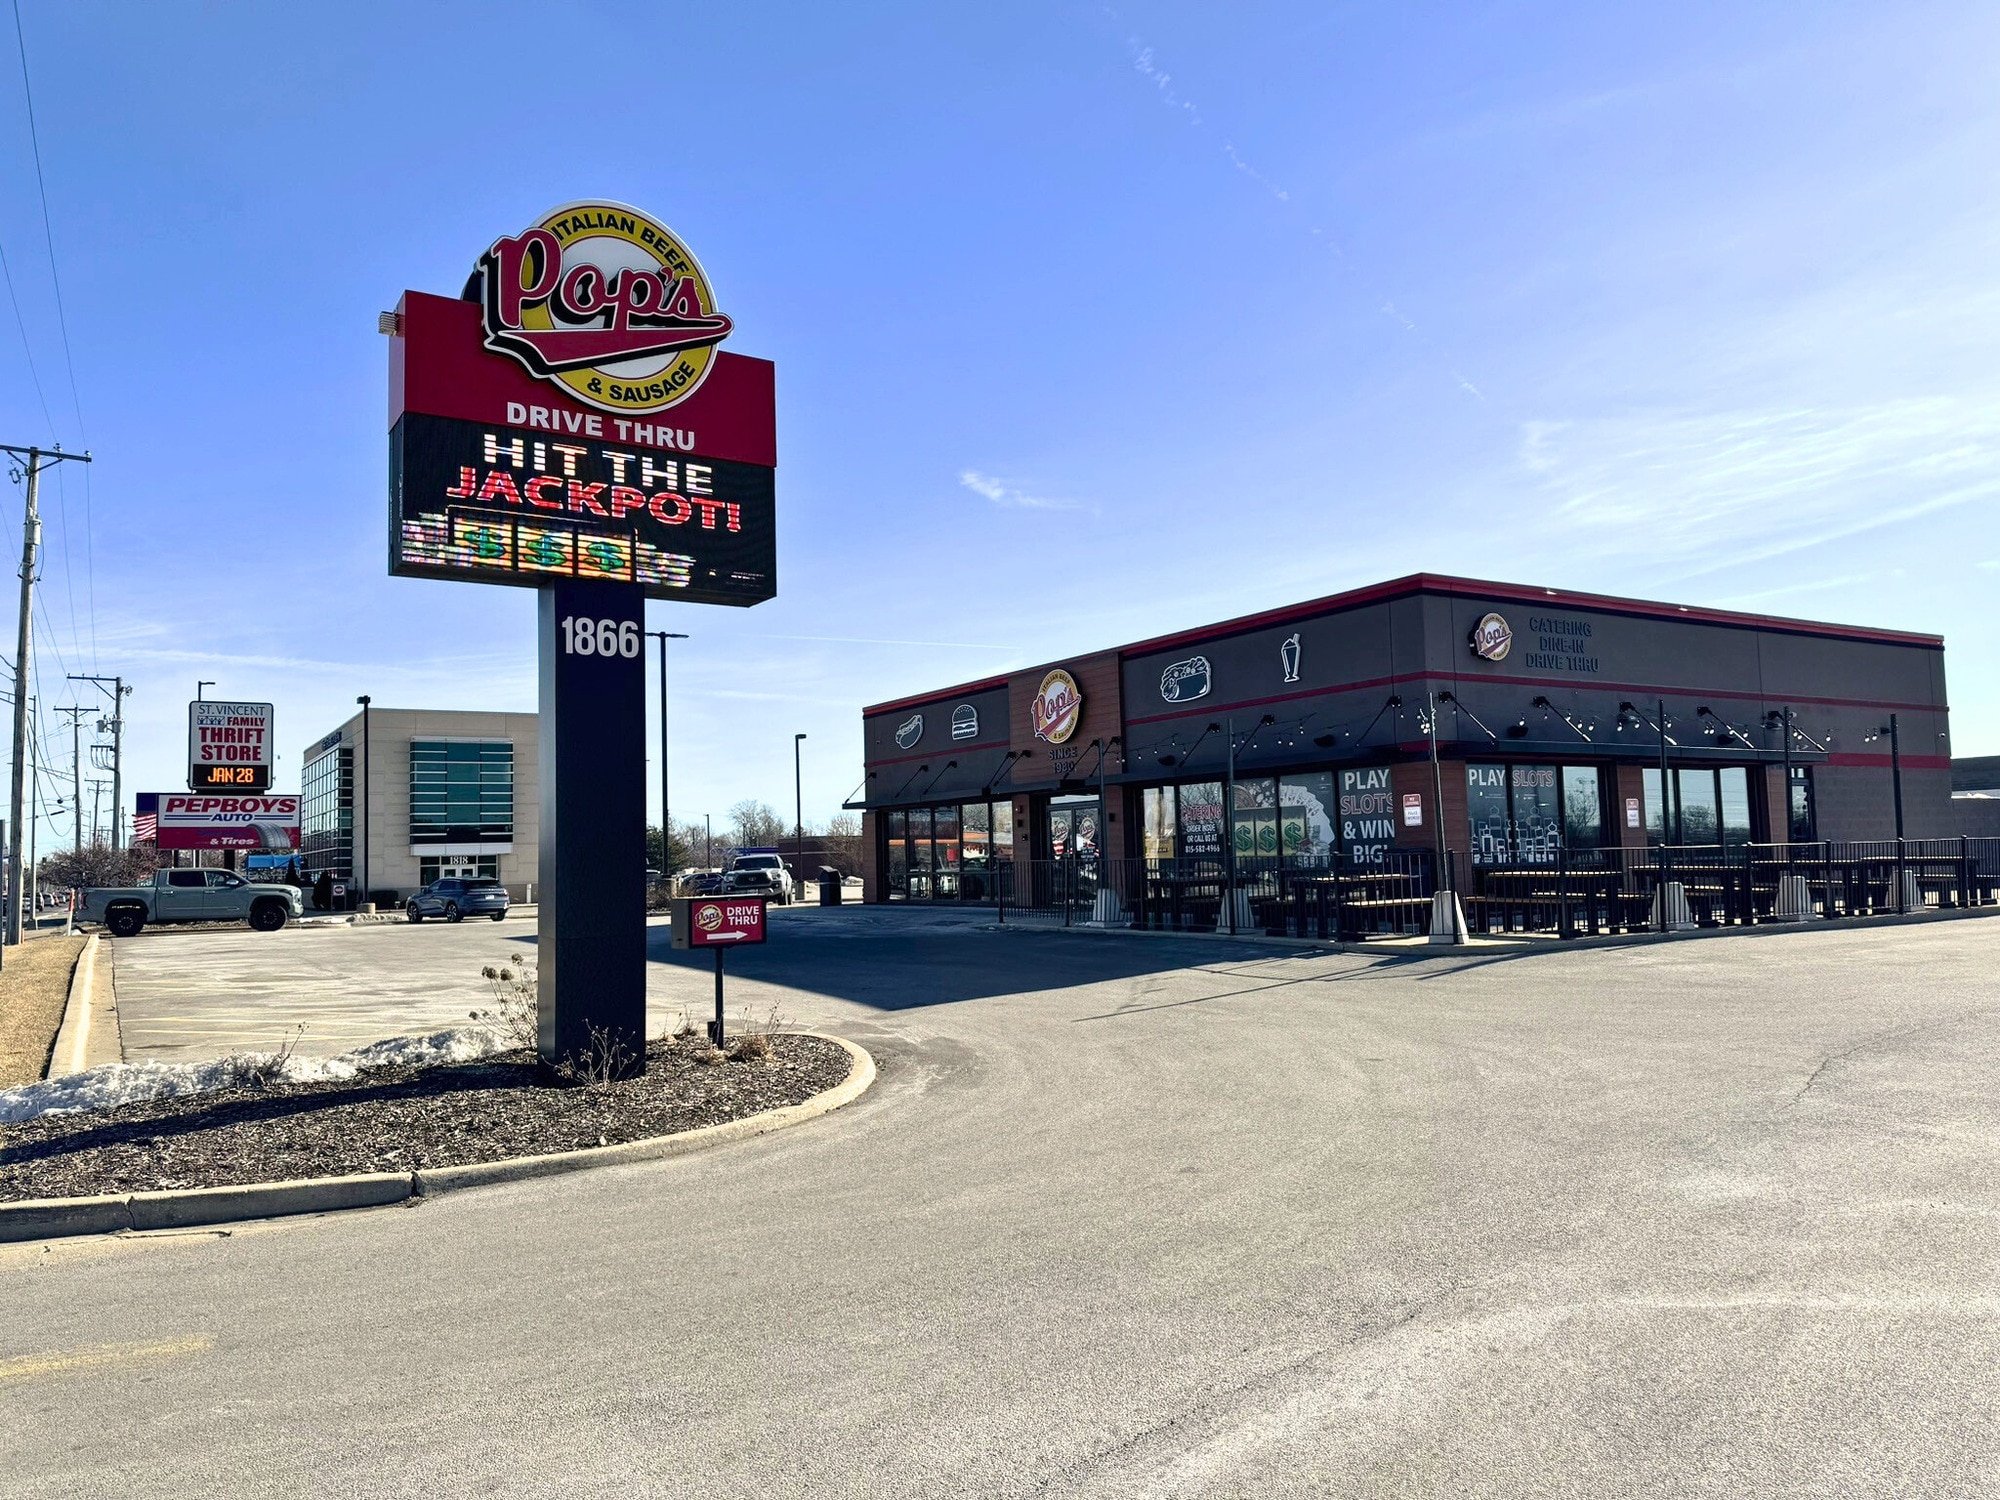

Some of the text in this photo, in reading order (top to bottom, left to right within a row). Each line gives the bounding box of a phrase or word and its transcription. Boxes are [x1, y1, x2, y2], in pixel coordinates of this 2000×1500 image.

[551, 213, 690, 274] ITALIAN BEEF
[487, 227, 706, 333] Pop's
[587, 361, 696, 402] & SAUSAGE
[507, 402, 695, 451] DRIVE THRU
[484, 434, 713, 494] HIT THE
[446, 466, 741, 532] JACKPOT!
[1529, 617, 1592, 637] CATERING
[562, 616, 639, 658] 1866
[1540, 636, 1584, 654] DINE-IN
[1526, 653, 1598, 672] DRIVE THRU
[199, 705, 265, 716] ST. VINCENT
[1033, 687, 1075, 732] Pop's
[227, 716, 265, 726] FAMILY
[199, 727, 265, 743] THRIFT
[201, 745, 262, 761] STORE
[1049, 746, 1077, 760] SINCE
[208, 767, 254, 783] JAN 28
[1344, 769, 1390, 790] PLAY
[1468, 769, 1554, 787] PLAY SLOTS
[166, 798, 296, 813] PEPBOYS
[1181, 804, 1222, 821] CATERING
[1340, 792, 1394, 815] SLOTS
[211, 813, 253, 822] AUTO
[1343, 819, 1395, 839] & WIN
[210, 836, 255, 845] & Tires
[450, 856, 468, 865] 1818
[726, 906, 759, 916] DRIVE
[728, 916, 758, 926] THRU
